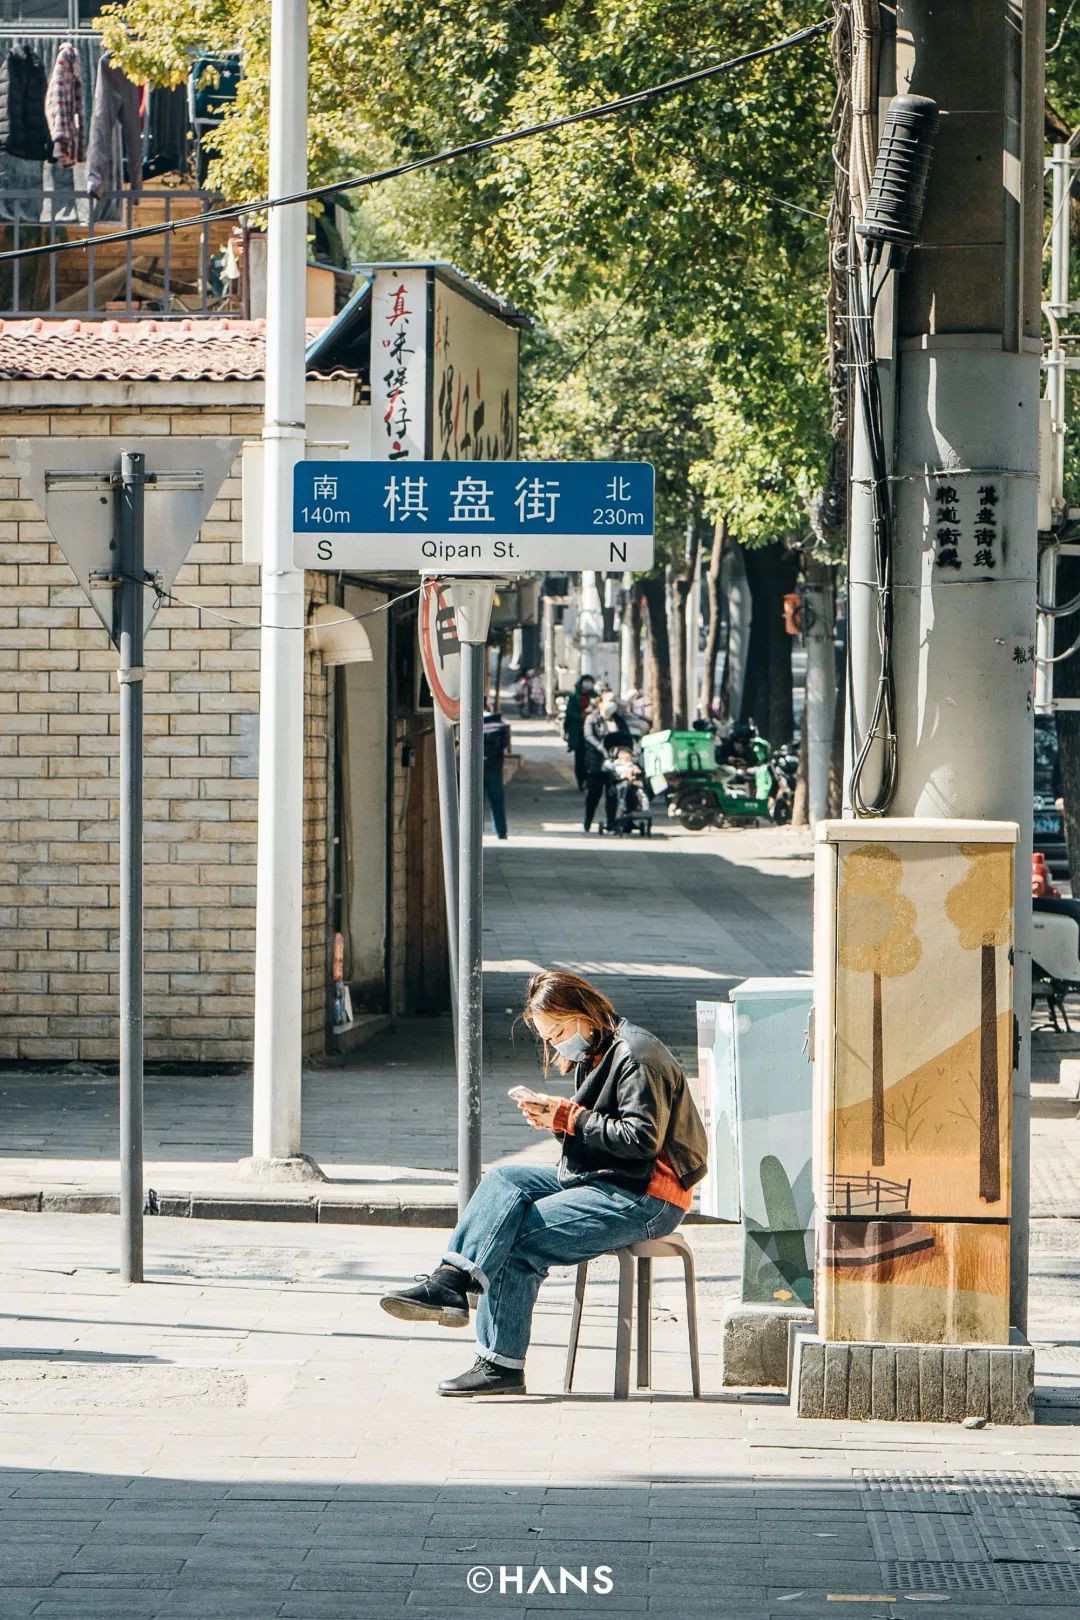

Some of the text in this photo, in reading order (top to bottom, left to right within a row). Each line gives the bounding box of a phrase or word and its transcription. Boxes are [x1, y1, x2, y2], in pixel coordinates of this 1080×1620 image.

[313, 474, 632, 523] 南 棋盘街 北
[301, 507, 644, 525] 140m 230m
[317, 540, 627, 562] S Qipan St. N
